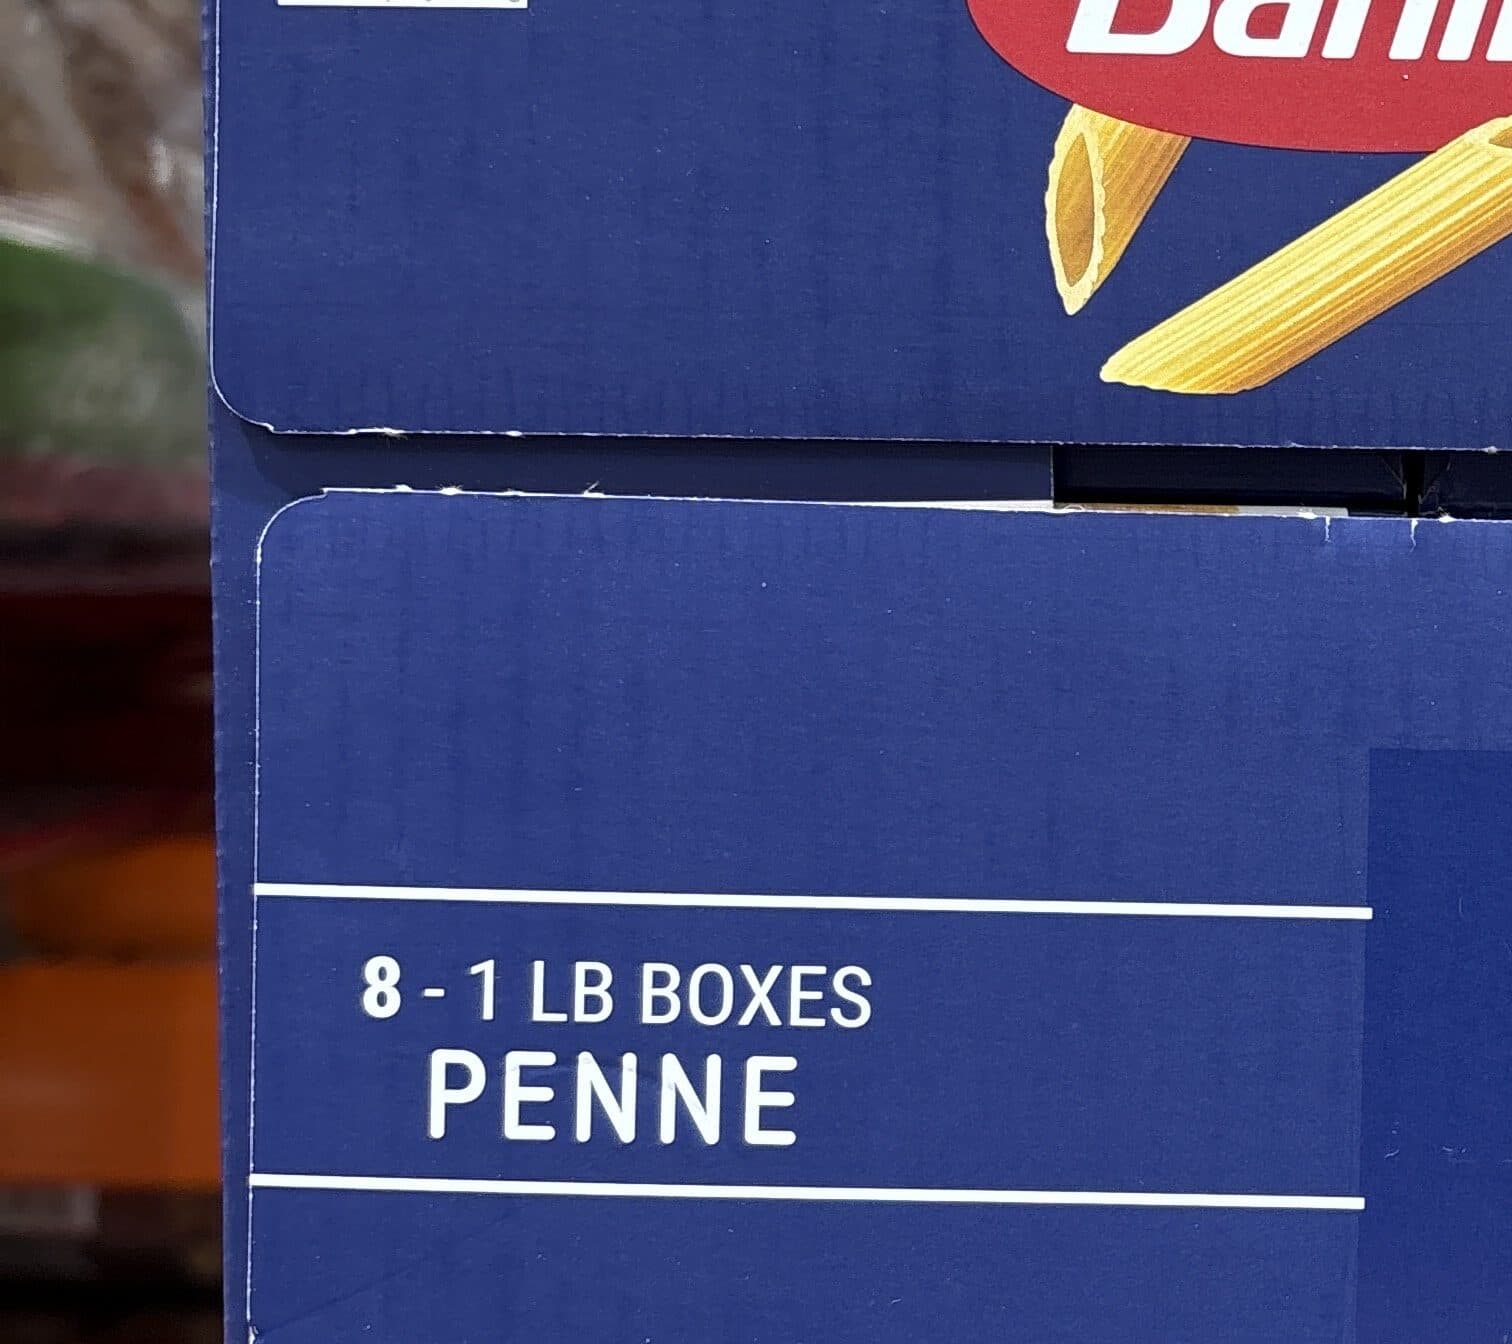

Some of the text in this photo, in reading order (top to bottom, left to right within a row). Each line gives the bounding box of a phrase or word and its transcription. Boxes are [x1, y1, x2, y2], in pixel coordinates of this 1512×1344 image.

[362, 955, 401, 1019] 8
[470, 959, 495, 1020] 1
[532, 960, 613, 1023] LB
[641, 962, 872, 1028] BOXES
[428, 1047, 798, 1146] PENNE
